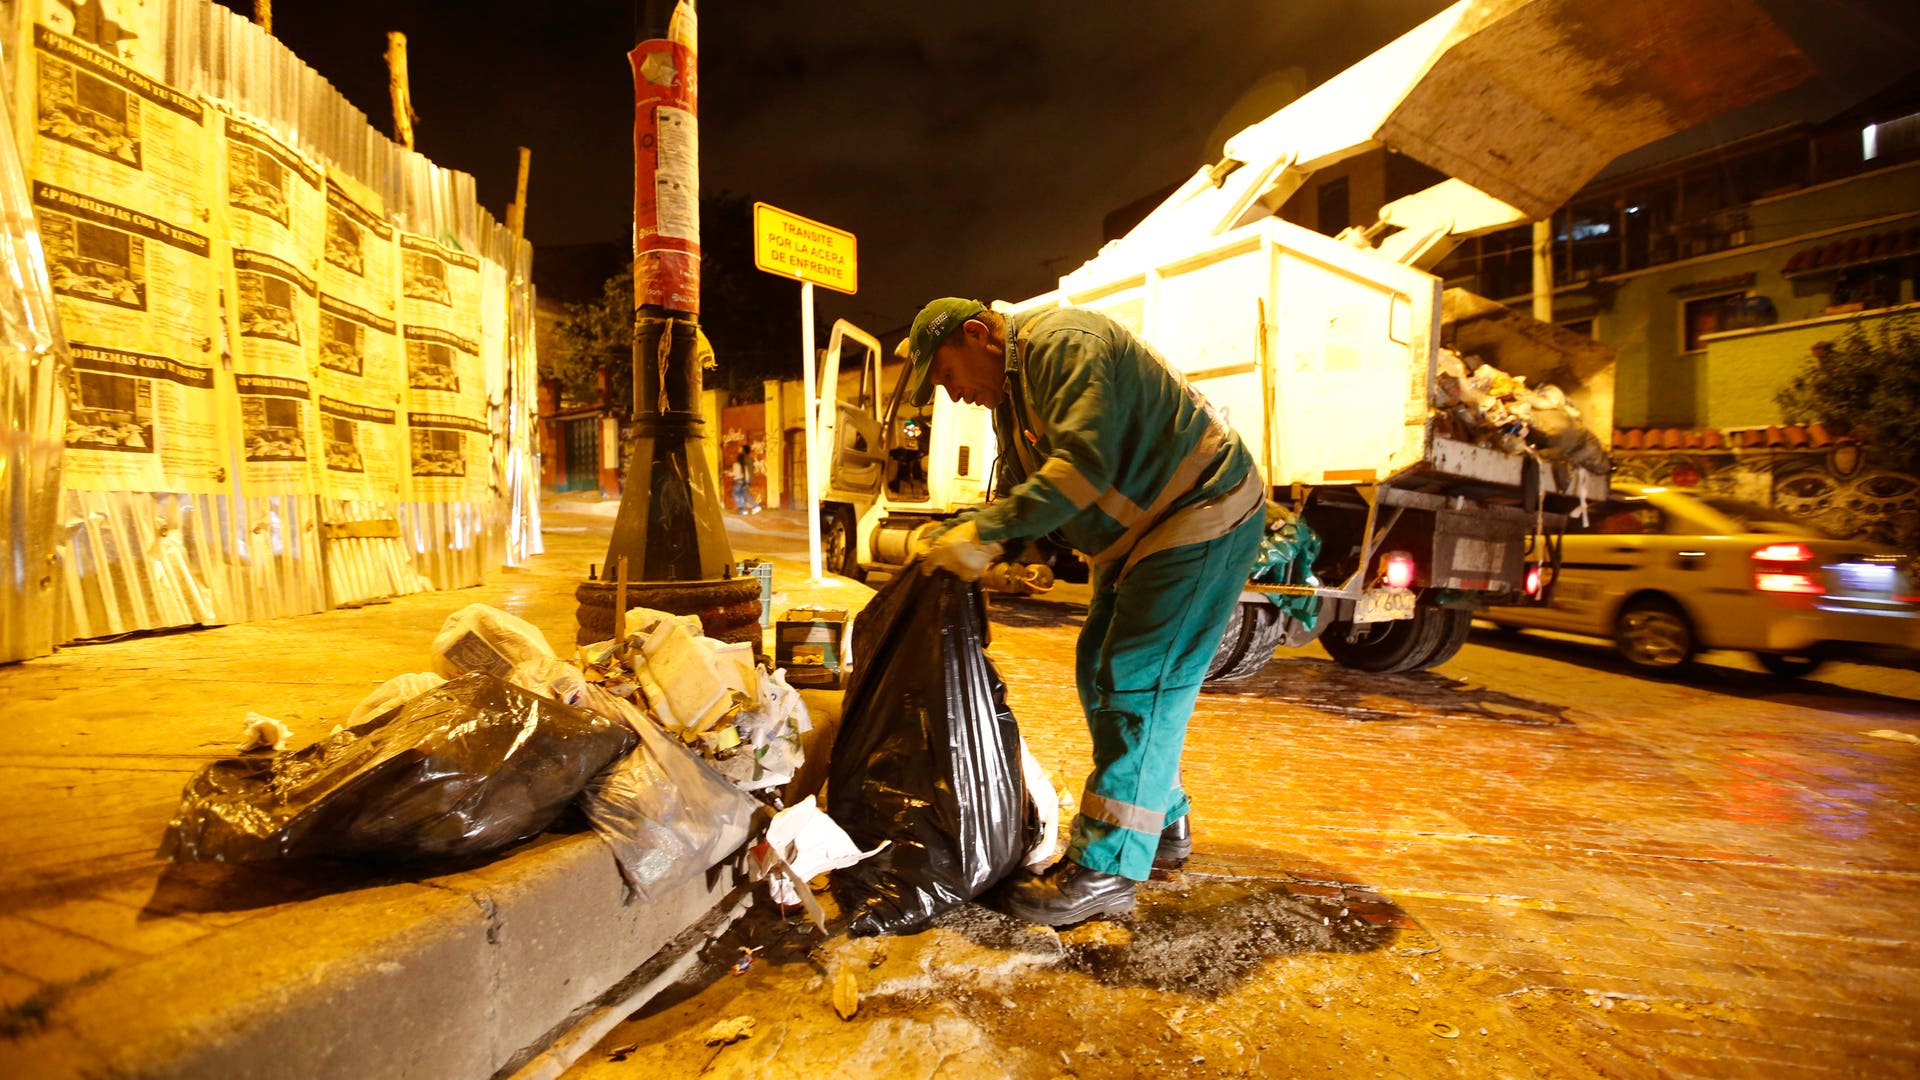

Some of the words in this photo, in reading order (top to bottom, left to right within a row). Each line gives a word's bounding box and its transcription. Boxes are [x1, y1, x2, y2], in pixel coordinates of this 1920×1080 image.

[40, 187, 131, 222] ¿PROBLEMAS
[767, 232, 792, 249] POR
[795, 241, 808, 253] LA
[810, 247, 845, 265] ACERA
[782, 221, 833, 248] TRANSITE
[771, 249, 786, 263] DE
[789, 255, 843, 280] ENFRENTE
[139, 357, 167, 370] CON
